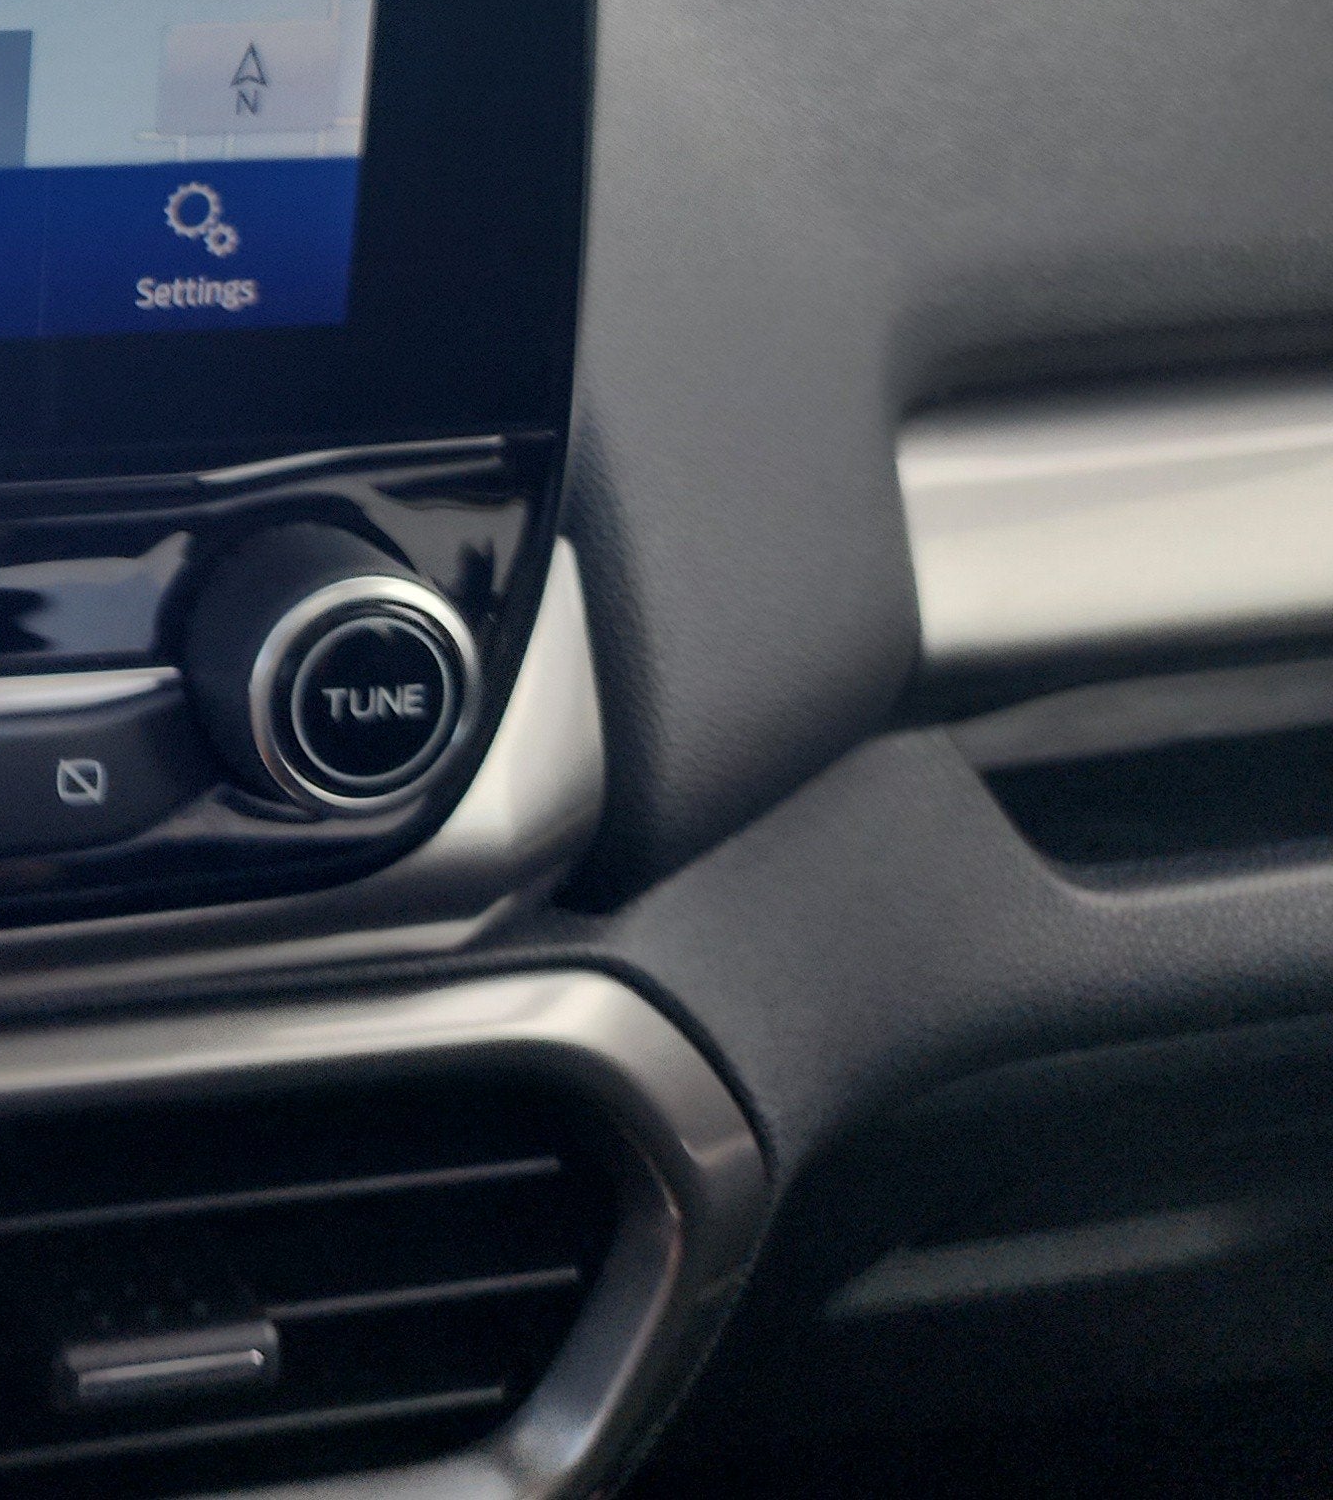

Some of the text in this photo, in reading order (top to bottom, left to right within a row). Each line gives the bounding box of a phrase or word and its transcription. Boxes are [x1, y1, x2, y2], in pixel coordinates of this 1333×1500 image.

[235, 90, 259, 115] N
[136, 276, 259, 311] Settings
[322, 683, 427, 720] TUNE
